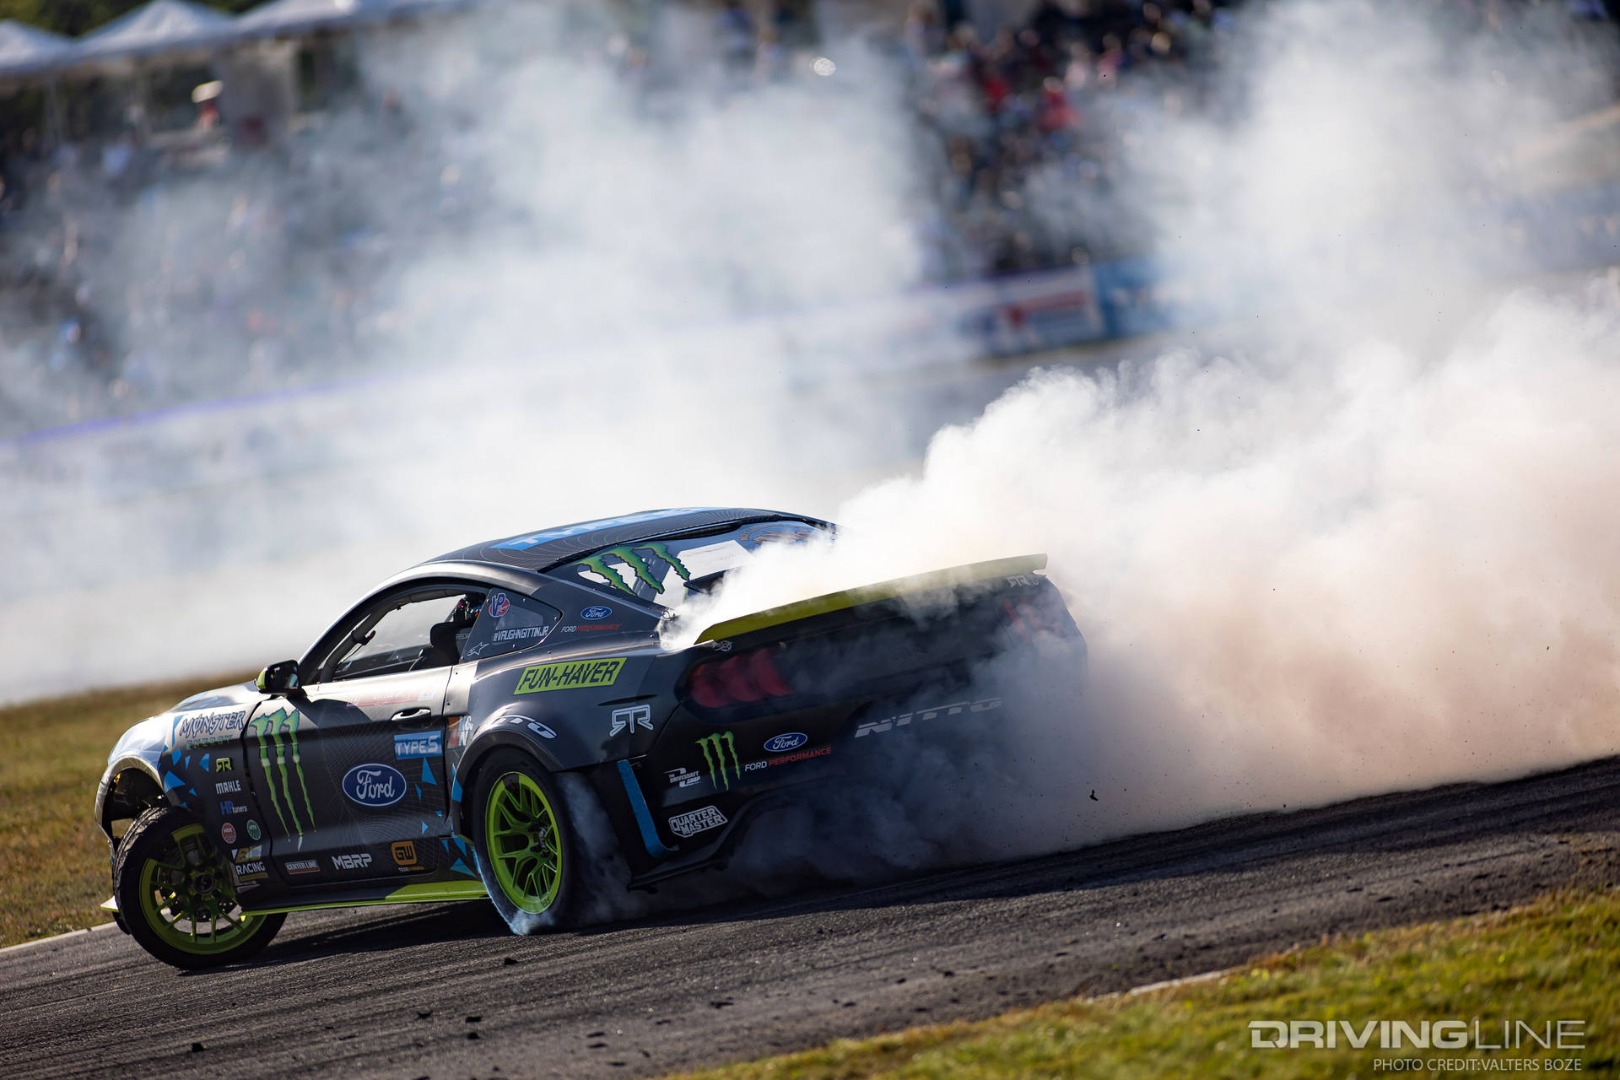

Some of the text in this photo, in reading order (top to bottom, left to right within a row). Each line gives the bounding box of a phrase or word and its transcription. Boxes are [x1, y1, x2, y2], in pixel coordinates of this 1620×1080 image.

[491, 592, 507, 617] VP
[561, 625, 577, 633] FORD
[517, 660, 621, 691] FUN-HAVER
[179, 710, 246, 738] MONSTER
[609, 704, 654, 737] RTR
[854, 697, 1003, 739] NITTO
[215, 757, 232, 773] RTR
[744, 746, 832, 772] FORD PERFORMANCE
[215, 780, 242, 795] MAHLE
[355, 769, 396, 800] Ford
[670, 807, 718, 832] QUARTER
[680, 815, 724, 835] MASTER
[235, 861, 266, 876] RACING
[331, 852, 373, 870] MBRP
